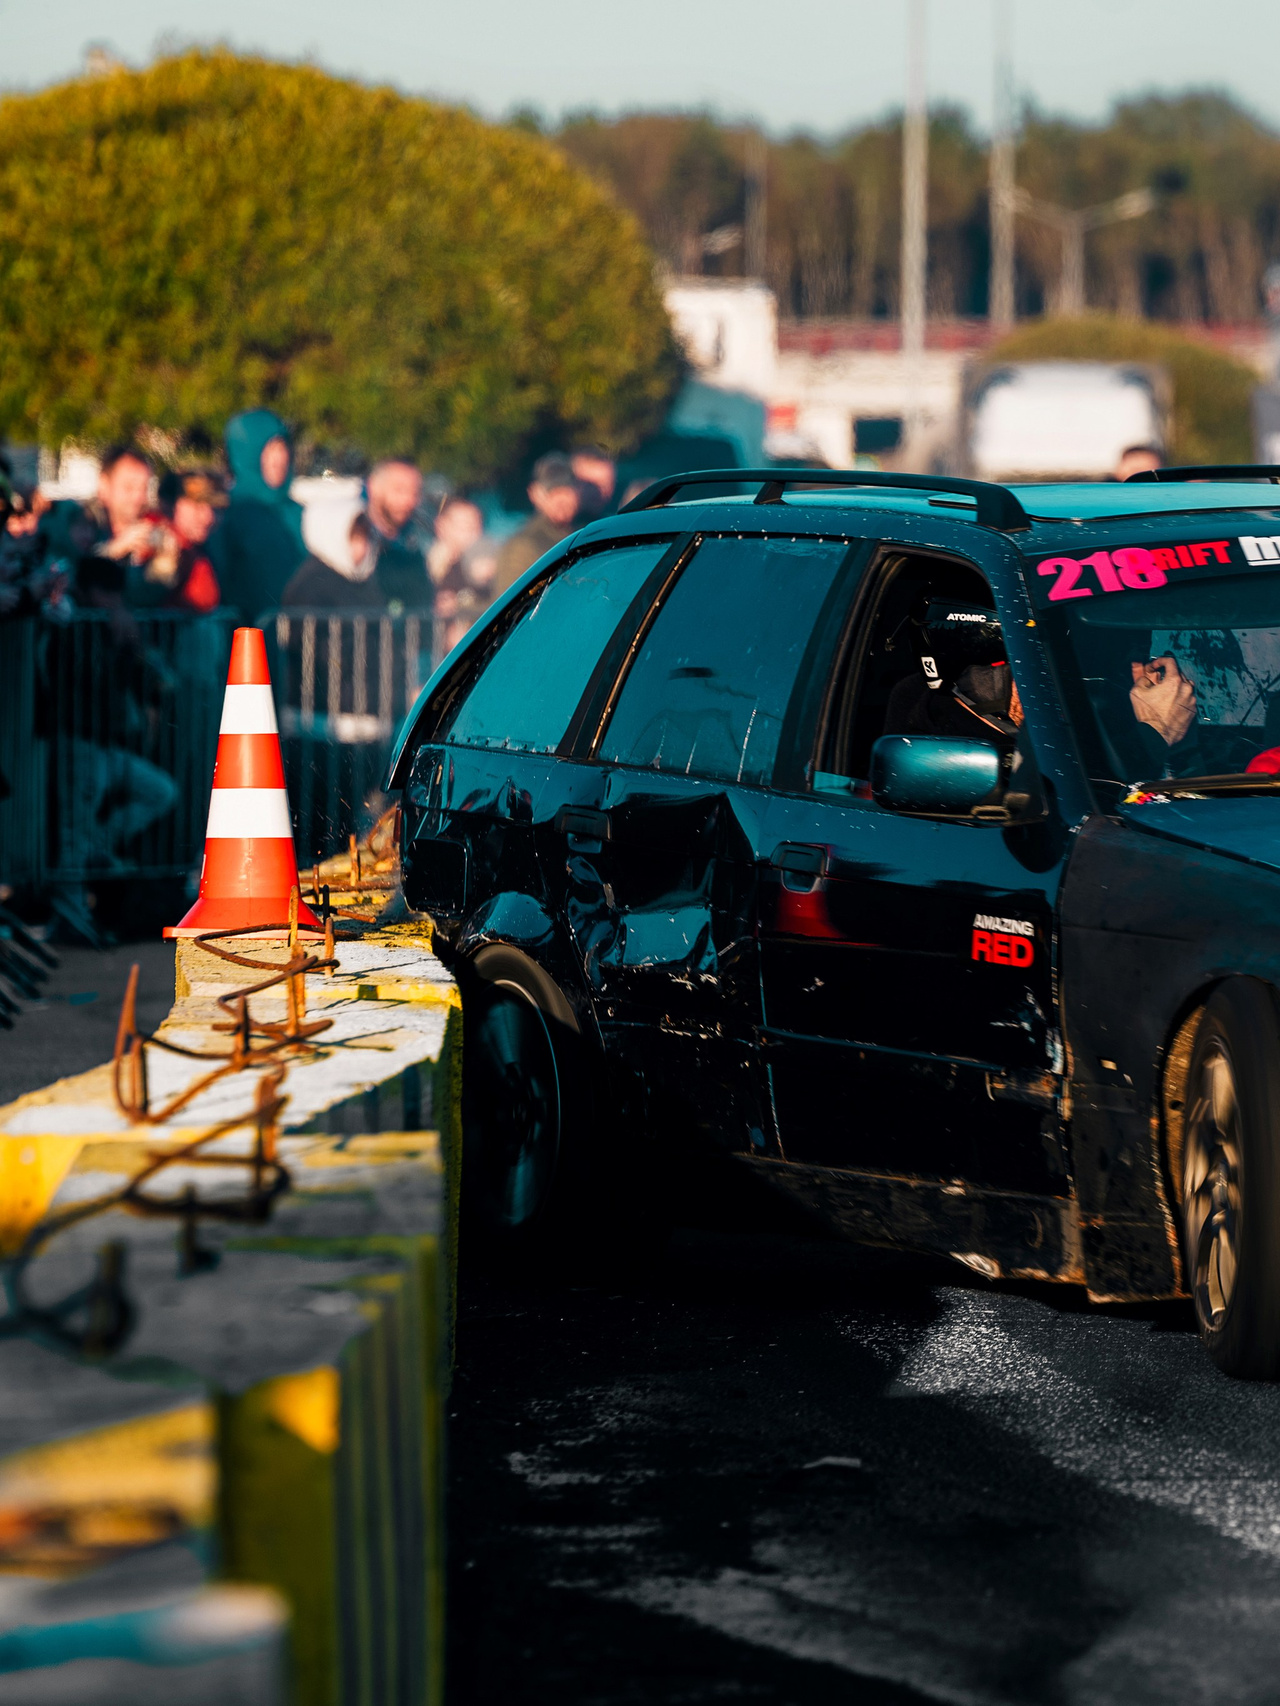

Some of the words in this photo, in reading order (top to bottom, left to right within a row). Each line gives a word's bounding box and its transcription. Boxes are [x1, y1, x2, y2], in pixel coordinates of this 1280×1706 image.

[1036, 547, 1168, 601] 218
[946, 612, 987, 623] ATOMIC
[972, 913, 1035, 937] AMAZING
[971, 928, 1035, 969] RED
